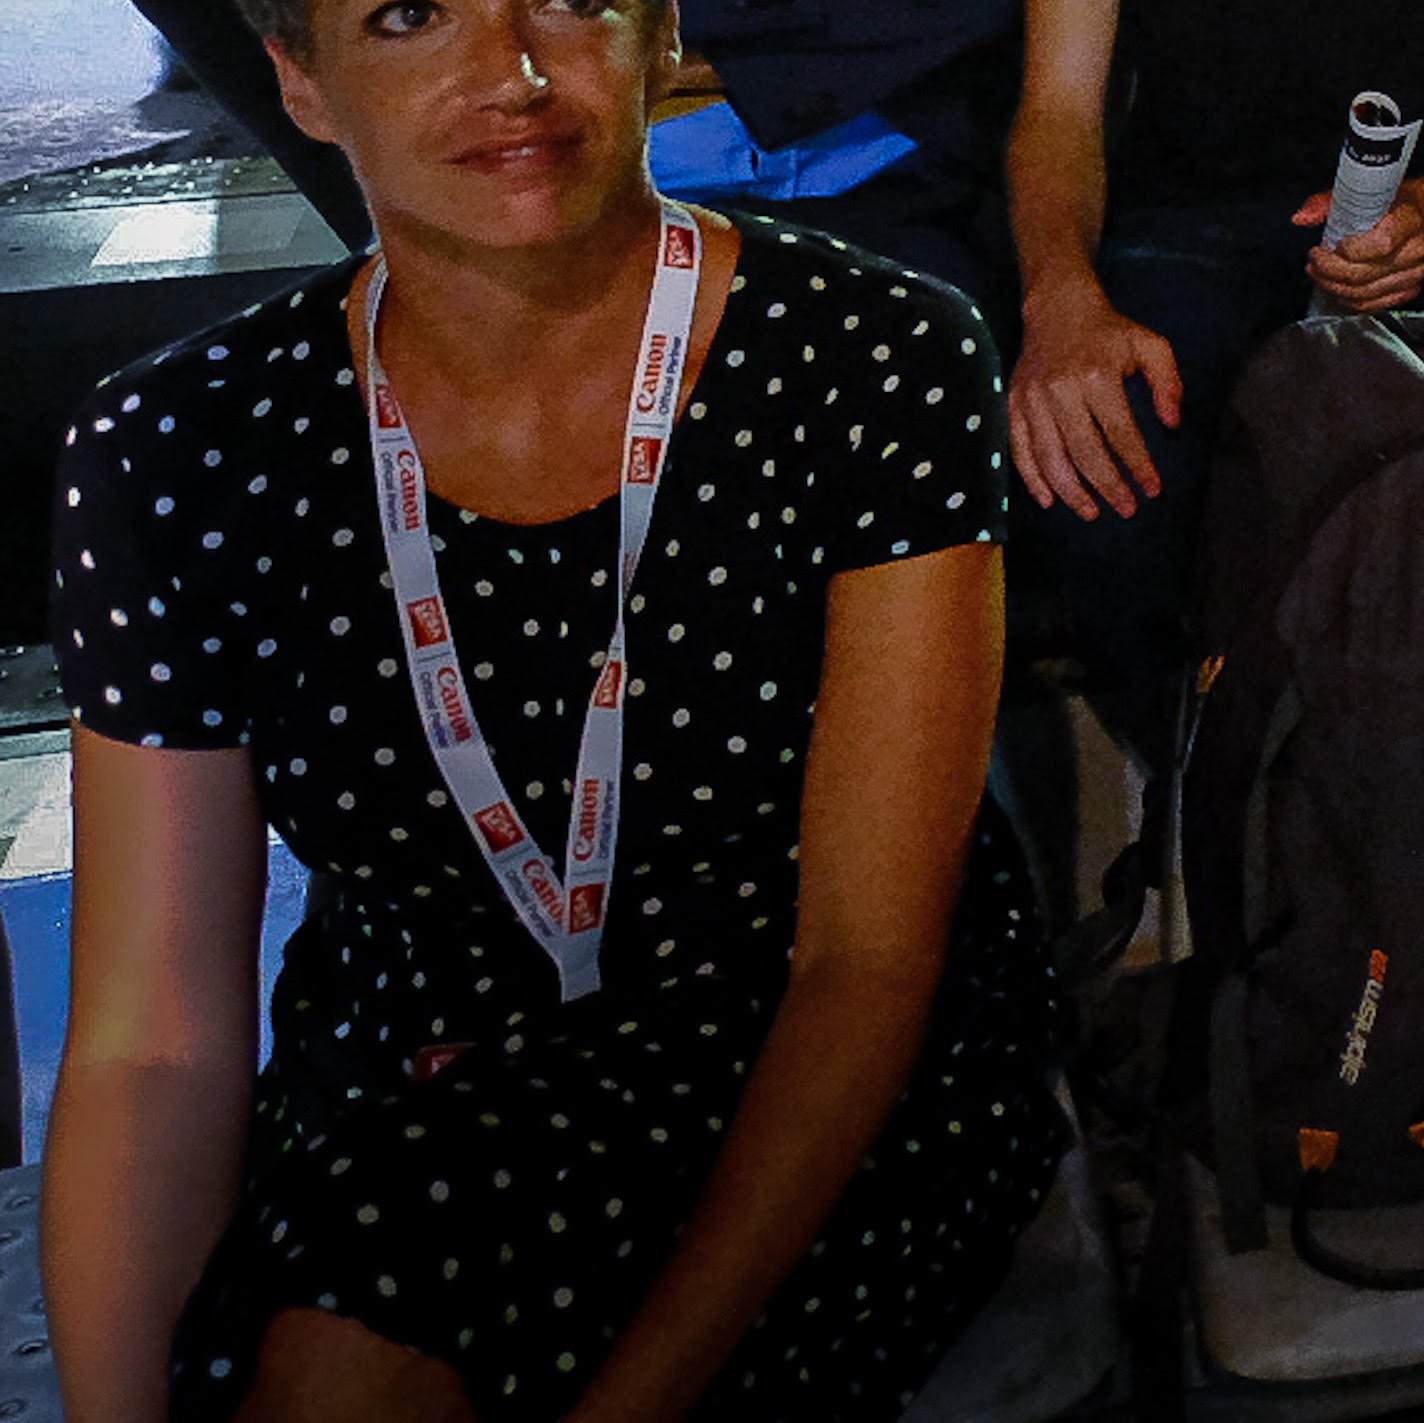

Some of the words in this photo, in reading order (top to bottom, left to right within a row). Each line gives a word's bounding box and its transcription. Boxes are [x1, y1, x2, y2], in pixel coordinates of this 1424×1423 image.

[637, 333, 667, 414] Canon
[666, 335, 682, 375] Partner
[658, 375, 675, 417] Official
[396, 448, 422, 531] Canon
[436, 665, 474, 743] Canon
[572, 778, 601, 862] Canon
[522, 858, 566, 924] Cano
